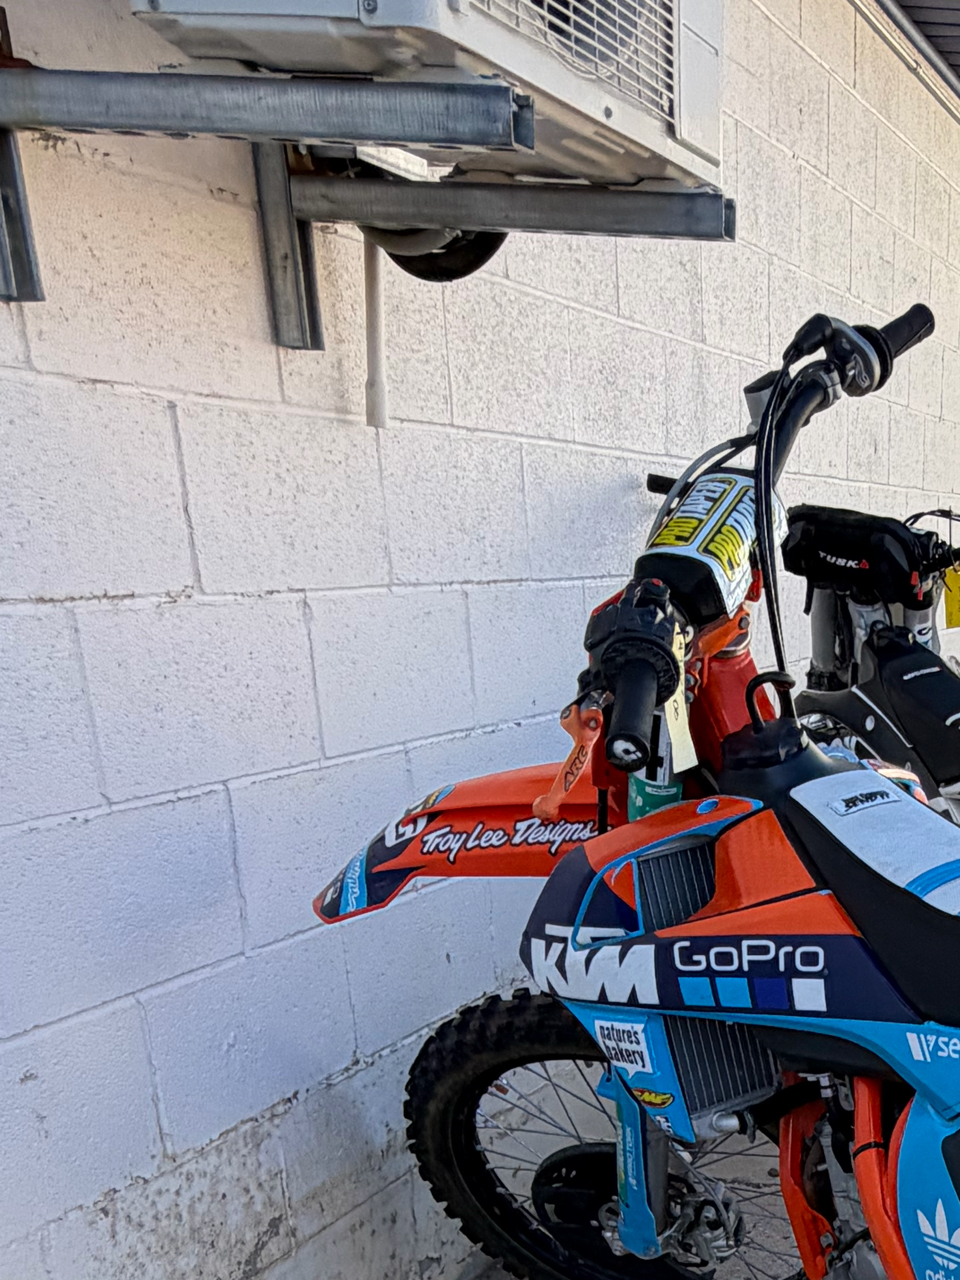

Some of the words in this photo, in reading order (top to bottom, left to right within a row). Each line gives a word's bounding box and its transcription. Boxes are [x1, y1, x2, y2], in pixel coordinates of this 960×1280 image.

[818, 550, 860, 569] TUSK
[564, 745, 588, 791] ARC
[421, 825, 466, 864] Troy
[465, 821, 508, 850] Lee
[511, 817, 599, 856] Designs
[531, 923, 659, 1005] KTM
[673, 940, 827, 973] GoPro
[599, 1024, 641, 1046] nature's
[602, 1039, 646, 1069] bakery
